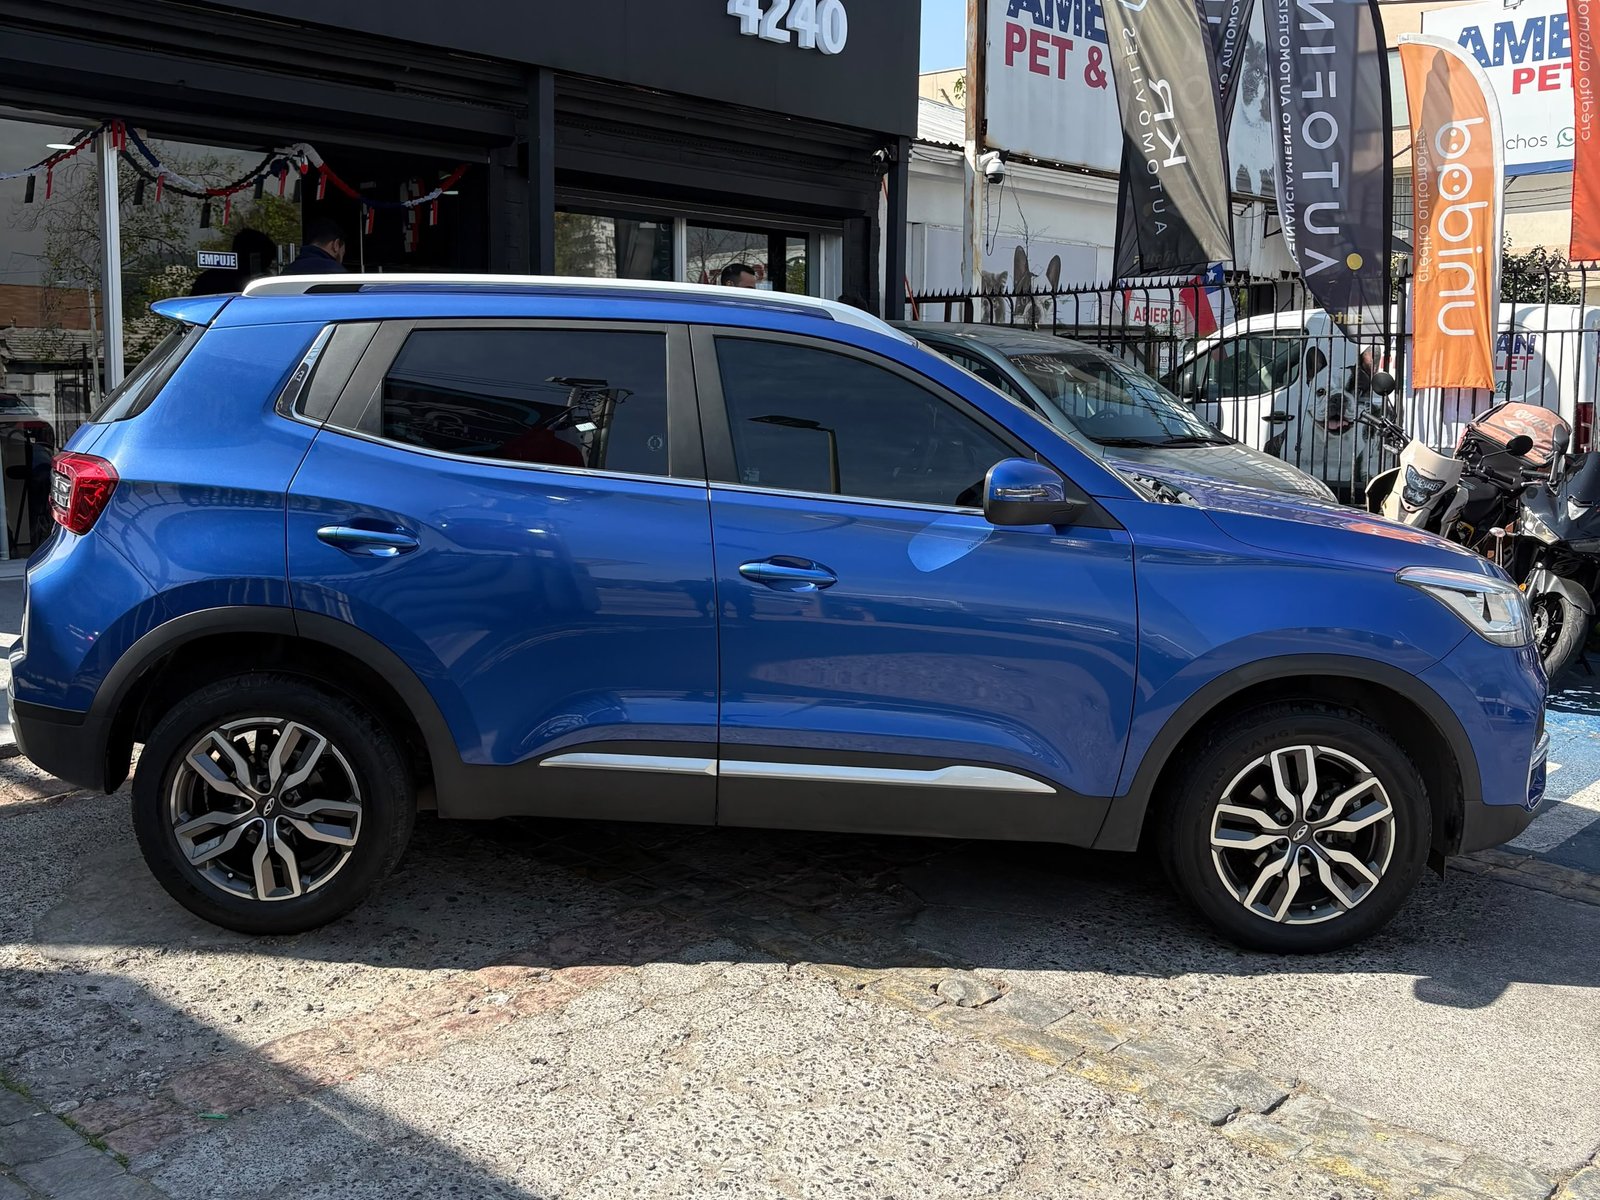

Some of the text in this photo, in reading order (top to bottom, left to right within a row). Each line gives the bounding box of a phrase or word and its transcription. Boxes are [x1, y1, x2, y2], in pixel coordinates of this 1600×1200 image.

[727, 0, 848, 54] 4240
[1004, 21, 1109, 90] PET &
[199, 253, 236, 267] EMPUJE
